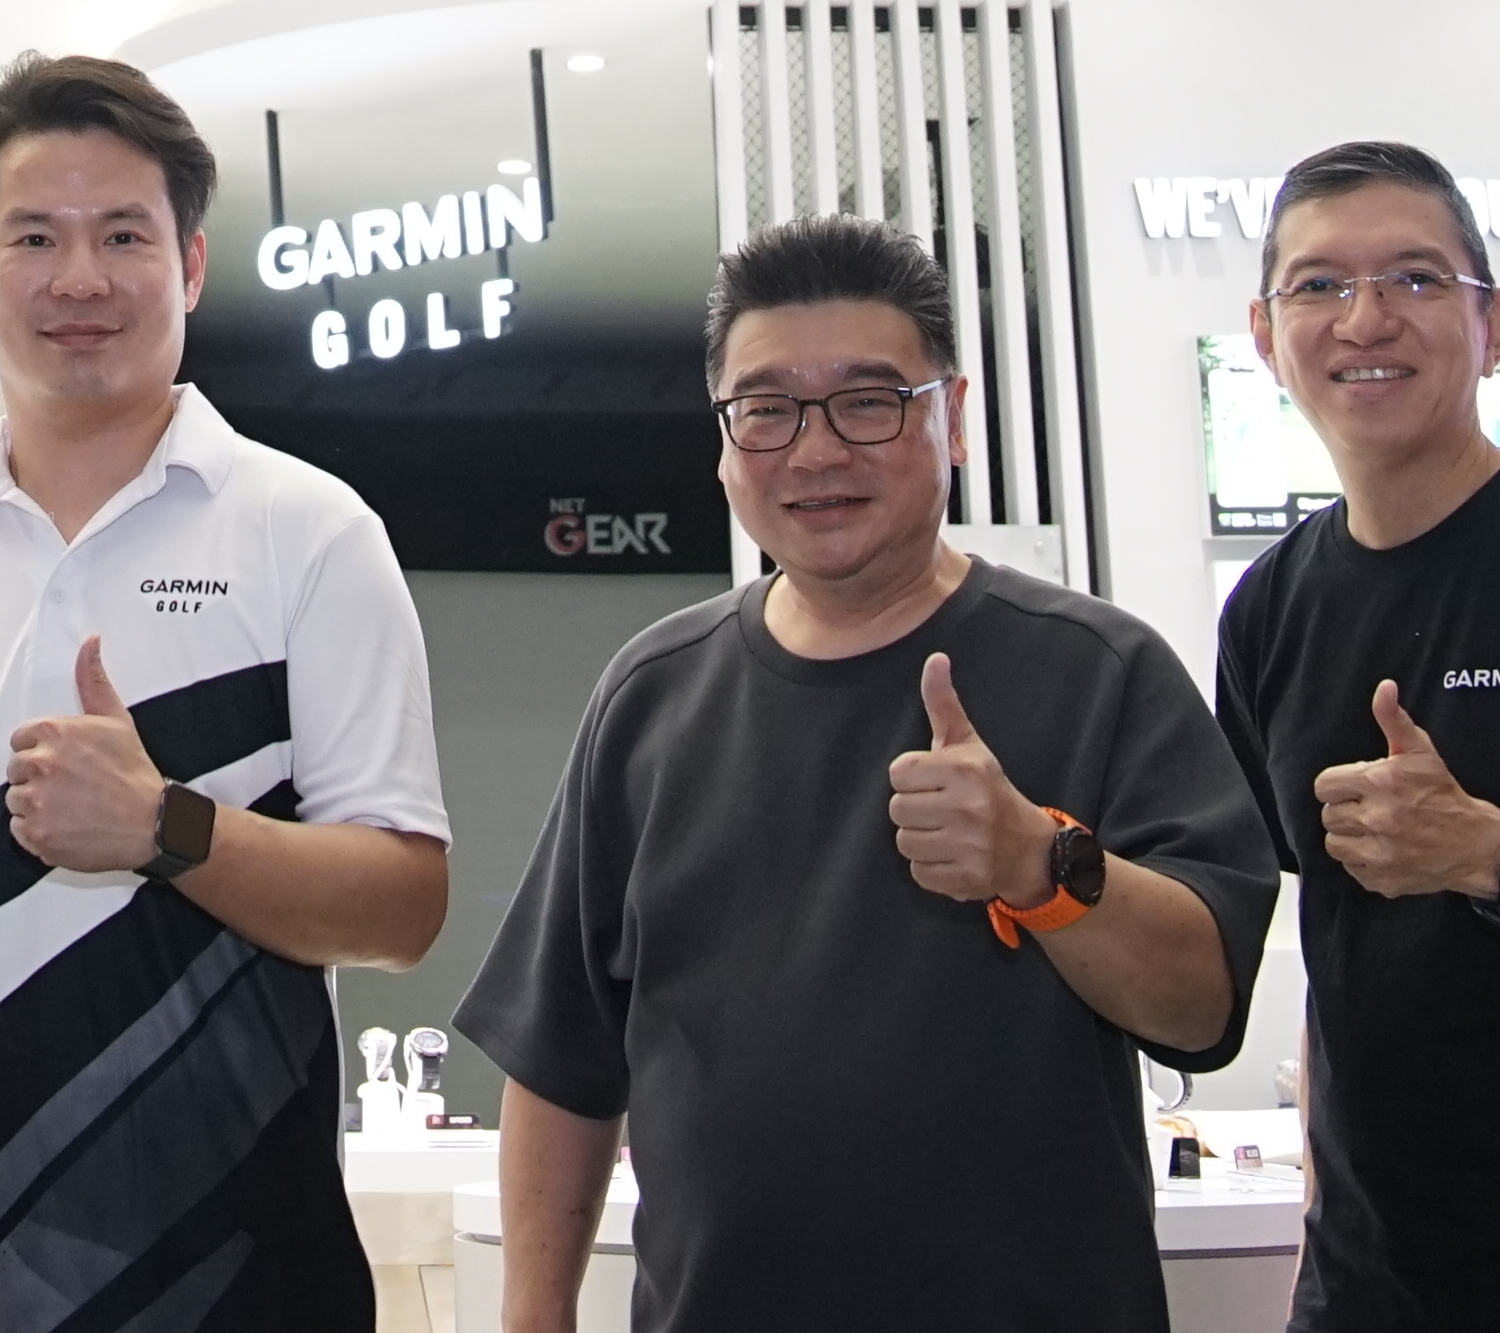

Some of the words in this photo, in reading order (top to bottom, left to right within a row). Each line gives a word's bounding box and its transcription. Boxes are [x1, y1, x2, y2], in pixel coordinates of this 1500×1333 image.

[257, 176, 544, 291] GARMIN
[311, 278, 514, 370] GOLF
[544, 513, 673, 556] GEAR
[140, 579, 228, 596] GARMIN
[156, 600, 202, 613] GOLF
